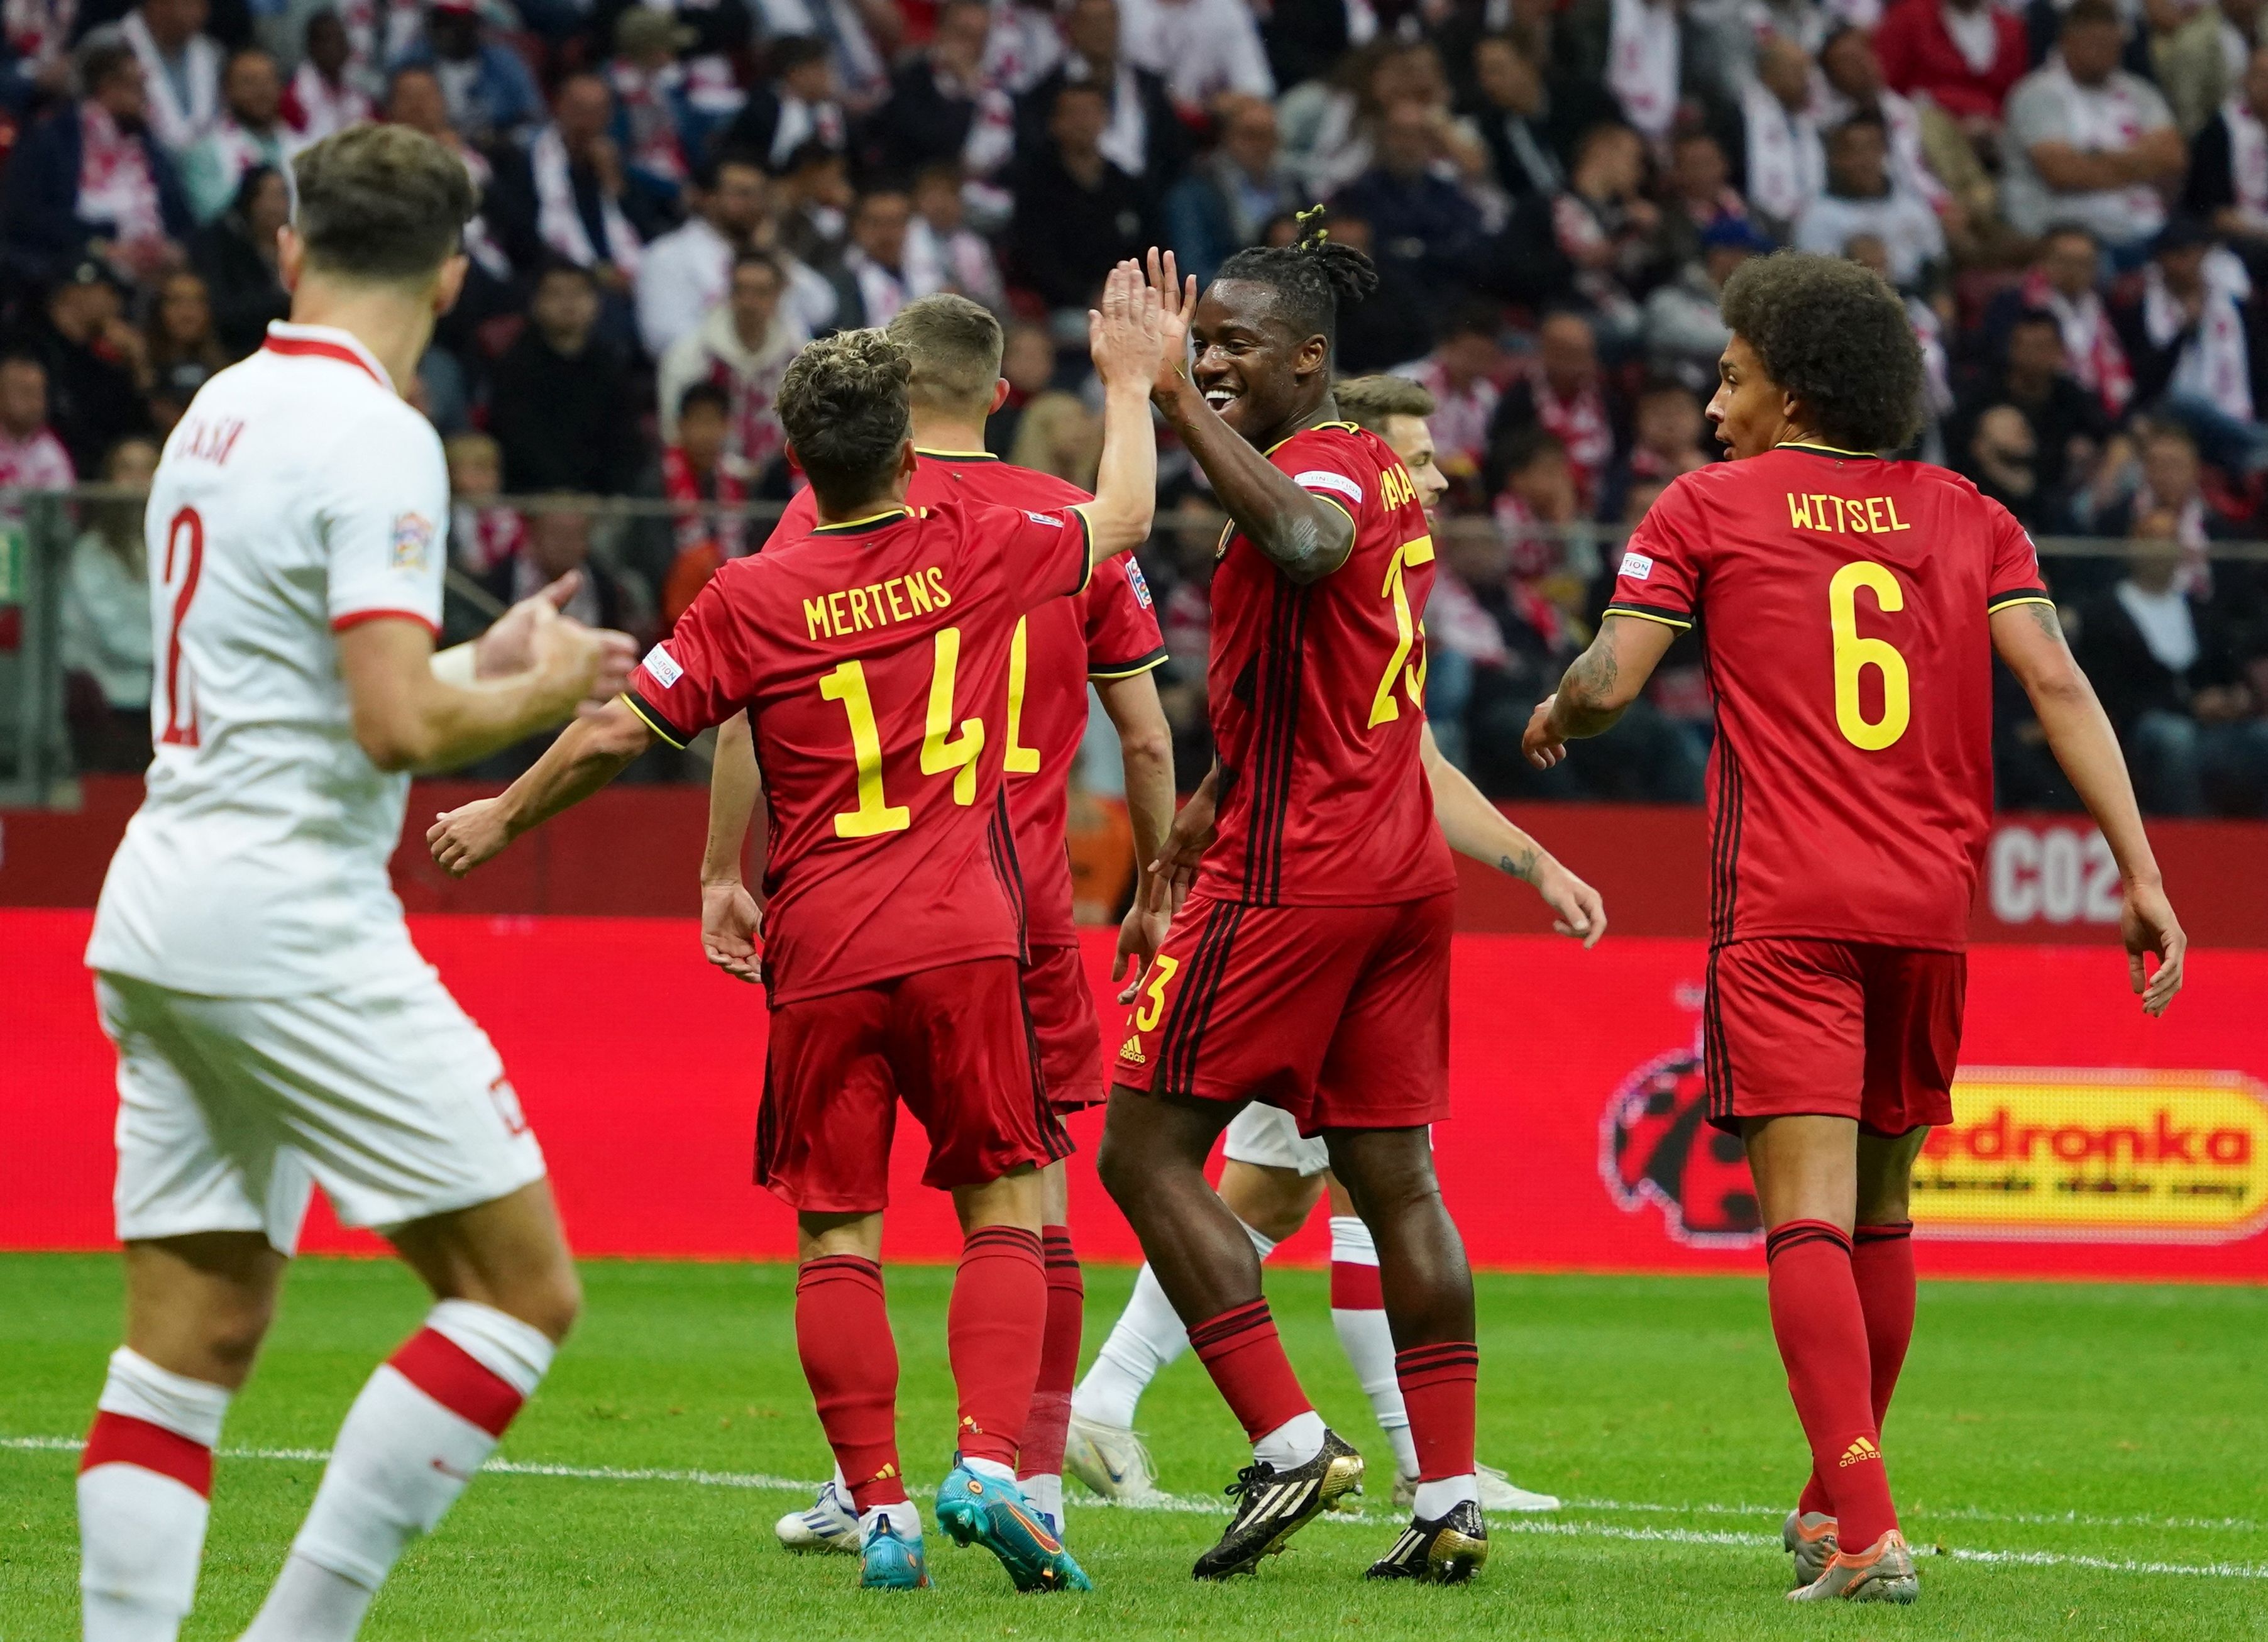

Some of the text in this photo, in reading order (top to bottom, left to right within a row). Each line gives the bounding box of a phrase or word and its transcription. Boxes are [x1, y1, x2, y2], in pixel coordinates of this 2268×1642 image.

[1786, 492, 1910, 534] WITSEL
[162, 504, 204, 749] 2
[802, 566, 952, 641] MERTENS
[1828, 560, 1911, 751] 6
[818, 626, 985, 838] 14
[1126, 954, 1180, 1032] 3
[1120, 1047, 1145, 1064] adidas
[1839, 1451, 1881, 1468] adidas
